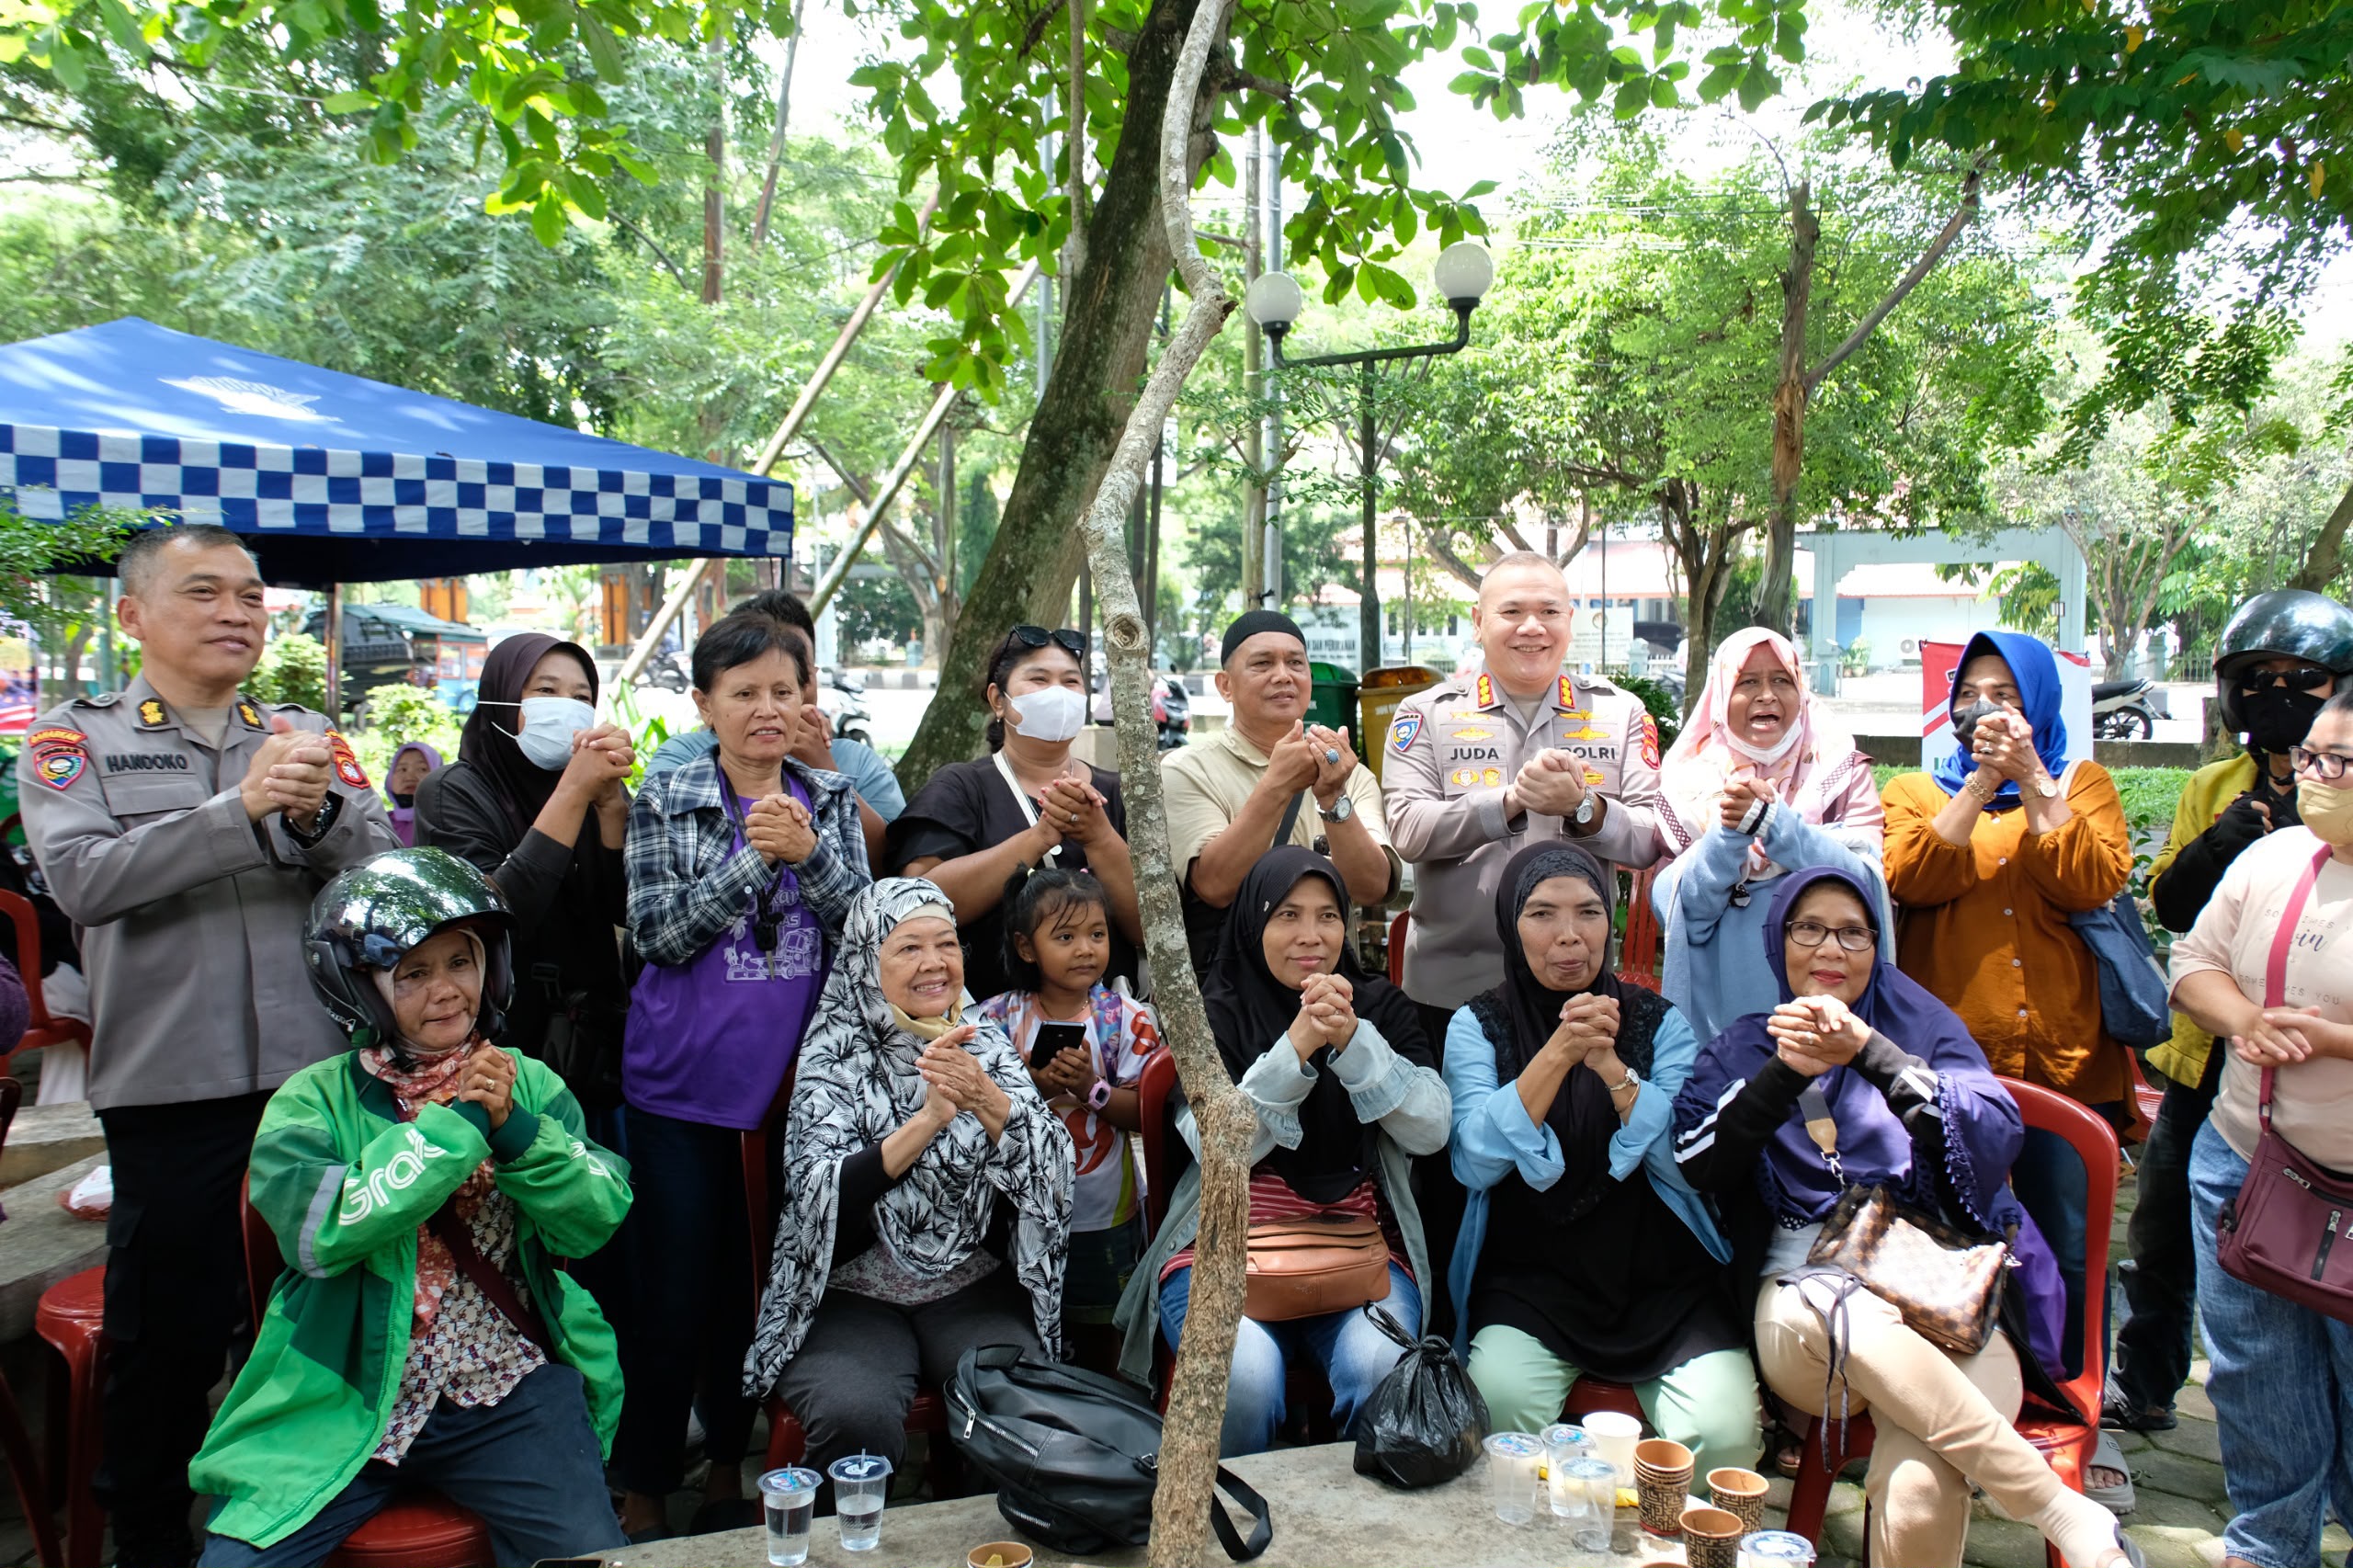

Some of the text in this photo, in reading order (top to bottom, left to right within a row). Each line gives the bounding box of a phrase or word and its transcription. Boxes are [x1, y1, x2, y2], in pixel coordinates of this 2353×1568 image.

[106, 754, 188, 773] HANDOKO
[1449, 747, 1499, 761] JUDA
[2290, 928, 2329, 953] in
